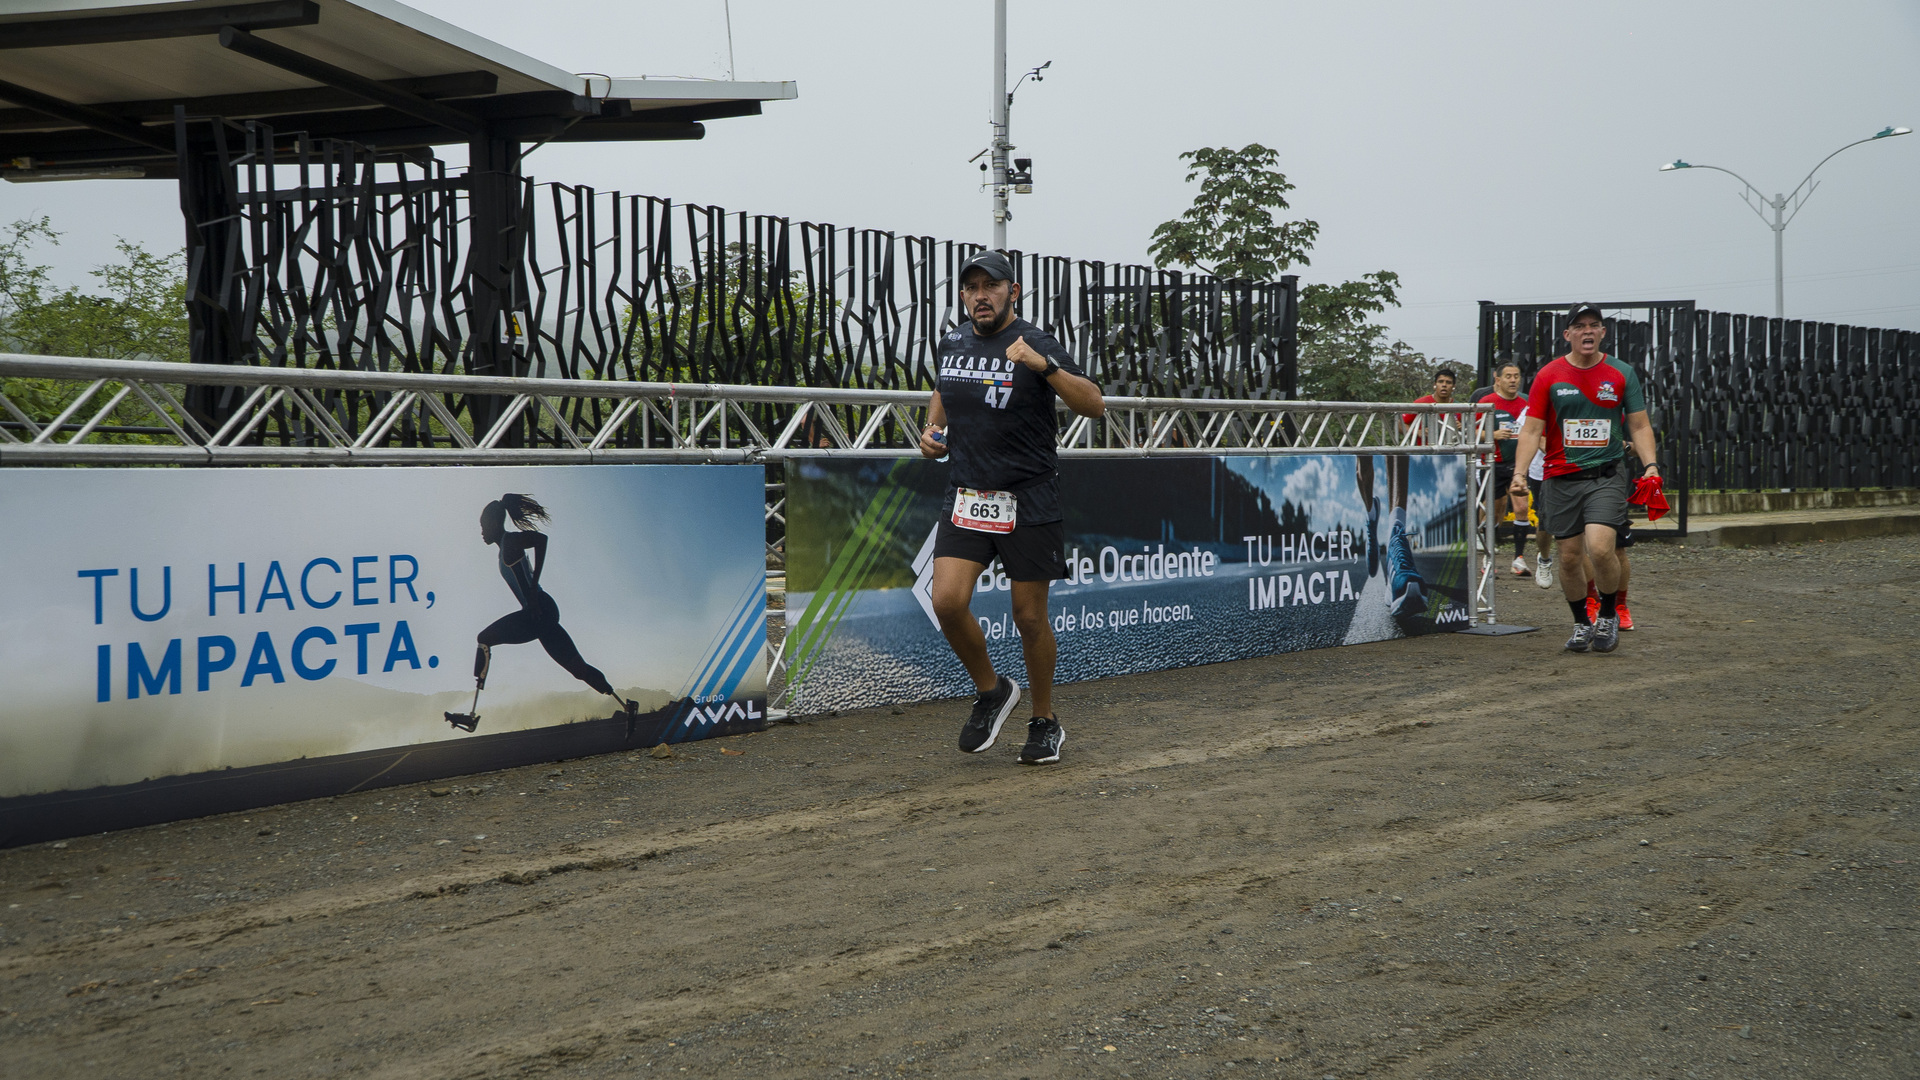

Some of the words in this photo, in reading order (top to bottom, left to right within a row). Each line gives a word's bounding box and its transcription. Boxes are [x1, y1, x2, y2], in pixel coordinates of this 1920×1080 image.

[984, 386, 1013, 409] 47
[1575, 428, 1598, 439] 182
[970, 502, 1000, 519] 663
[1064, 547, 1094, 586] de
[1099, 544, 1215, 583] Occidente
[1243, 534, 1272, 568] TU
[1281, 530, 1359, 565] HACER,
[77, 566, 171, 625] TU
[208, 554, 436, 617] HACER,
[1249, 570, 1360, 610] IMPACTA.
[978, 613, 1007, 640] Del
[1054, 607, 1076, 633] de
[1081, 605, 1104, 630] los
[1109, 608, 1138, 633] que
[1143, 600, 1194, 624] hacen.
[1435, 607, 1469, 625] AVAL
[97, 620, 440, 703] IMPACTA.
[684, 700, 762, 728] AVAL
[694, 693, 725, 704] Grupo
